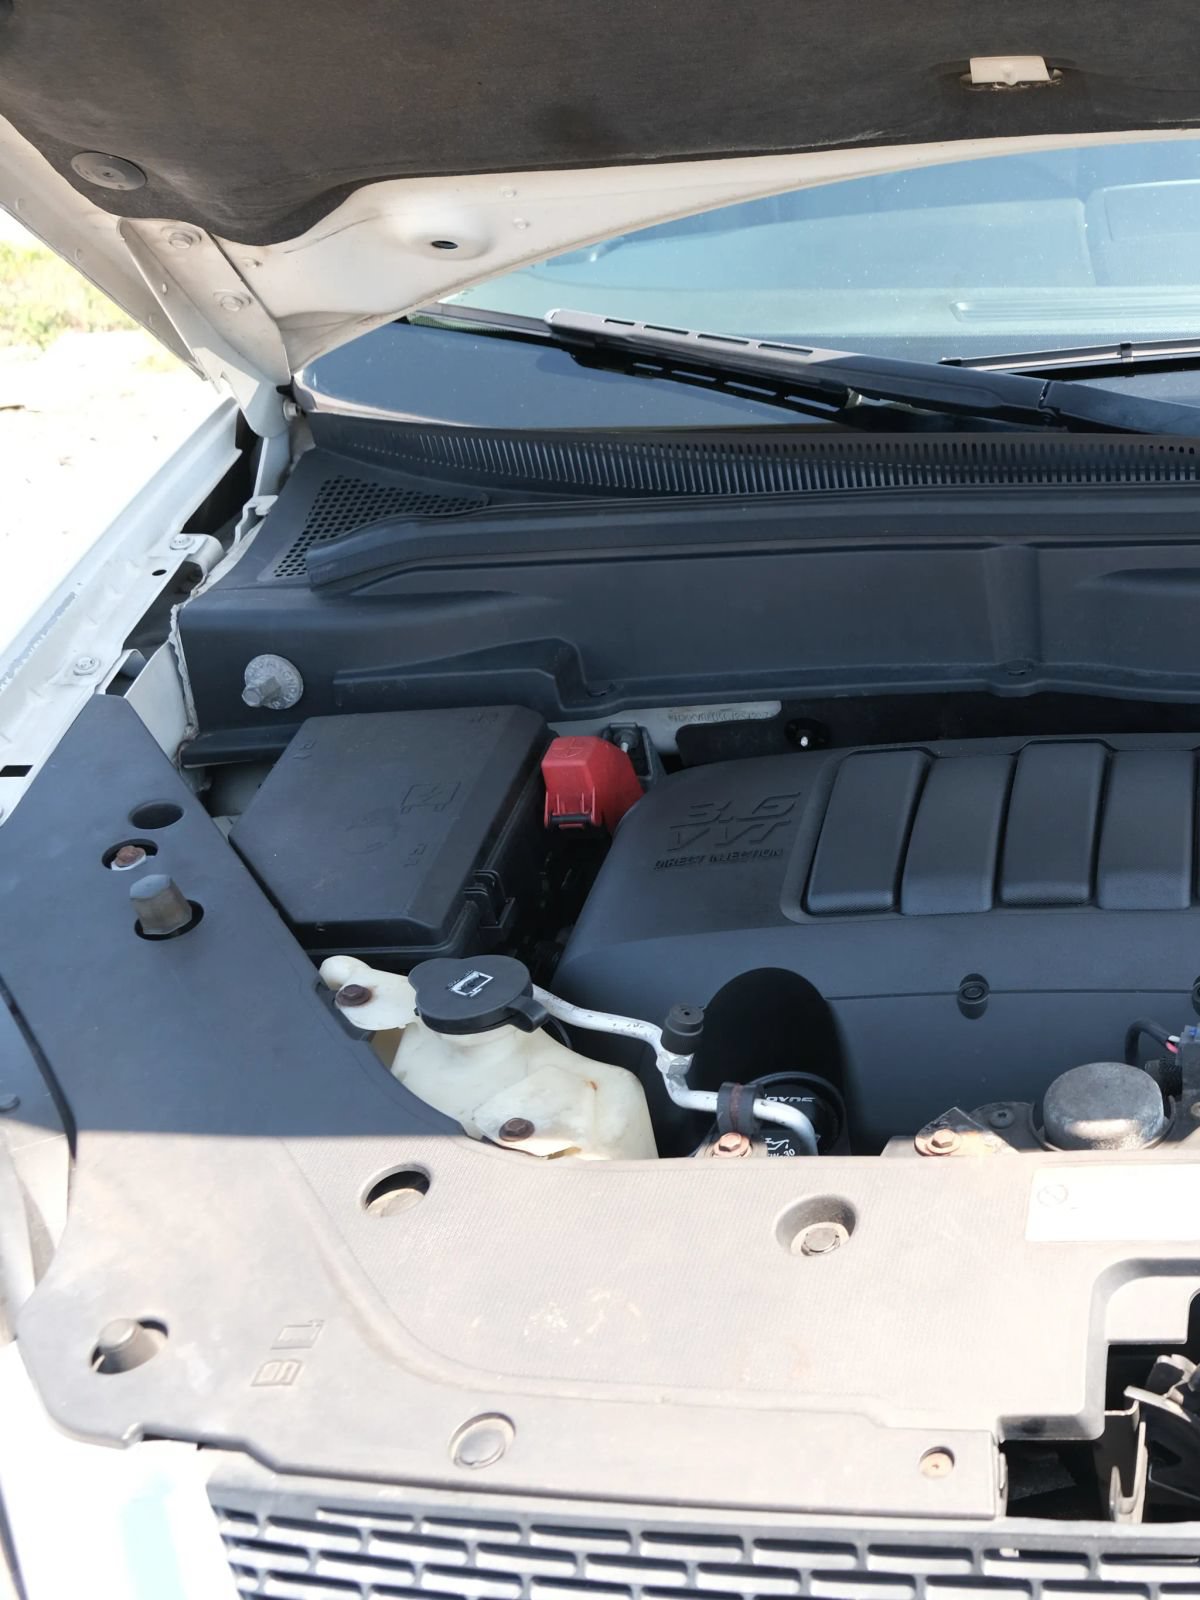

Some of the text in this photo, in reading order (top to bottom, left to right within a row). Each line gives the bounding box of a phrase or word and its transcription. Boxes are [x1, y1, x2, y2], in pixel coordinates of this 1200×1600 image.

[670, 793, 801, 829] 3.6
[665, 820, 792, 851] VVT
[654, 848, 785, 870] DIRECT INJECTION
